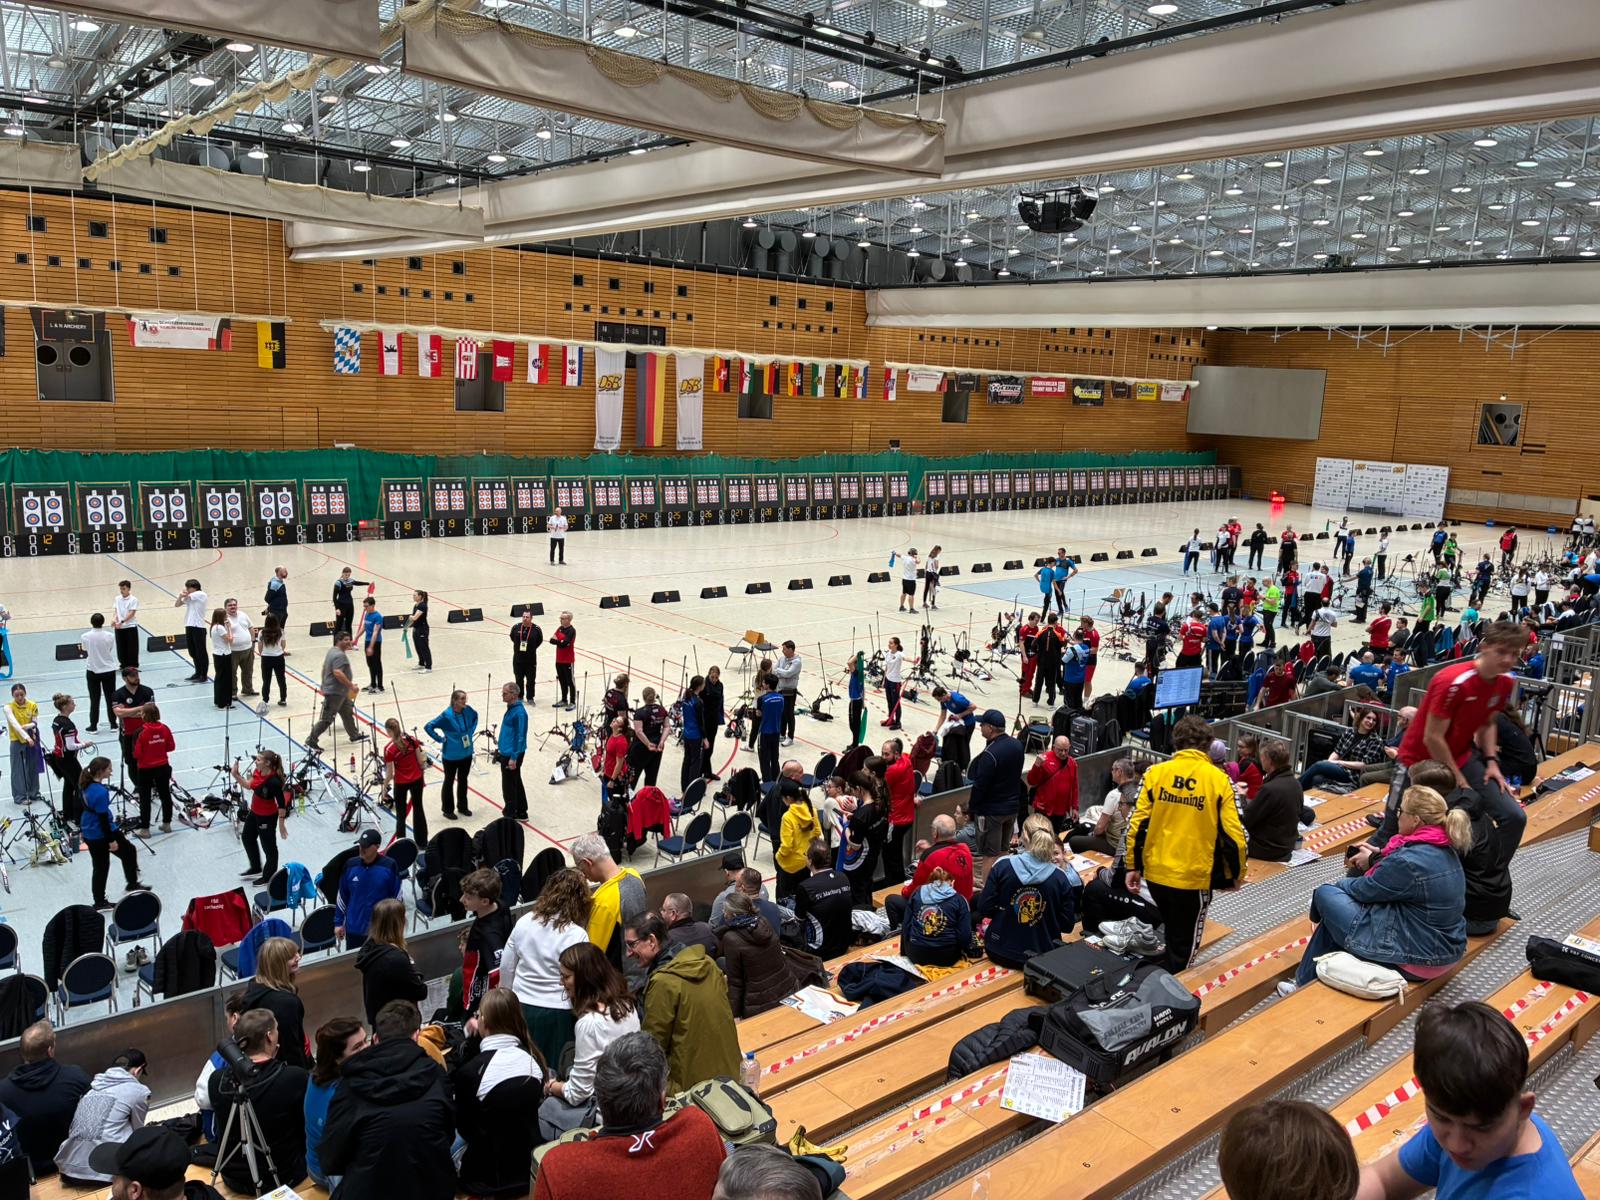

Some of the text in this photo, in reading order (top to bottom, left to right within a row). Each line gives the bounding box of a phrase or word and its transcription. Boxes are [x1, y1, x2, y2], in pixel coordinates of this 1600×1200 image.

[489, 519, 499, 528] 20
[223, 528, 233, 538] 15
[277, 526, 285, 536] 16
[43, 534, 53, 545] 12
[106, 532, 116, 543] 13
[1171, 775, 1197, 791] BC
[1158, 787, 1205, 811] Ismaning
[1124, 1020, 1187, 1066] AVALON
